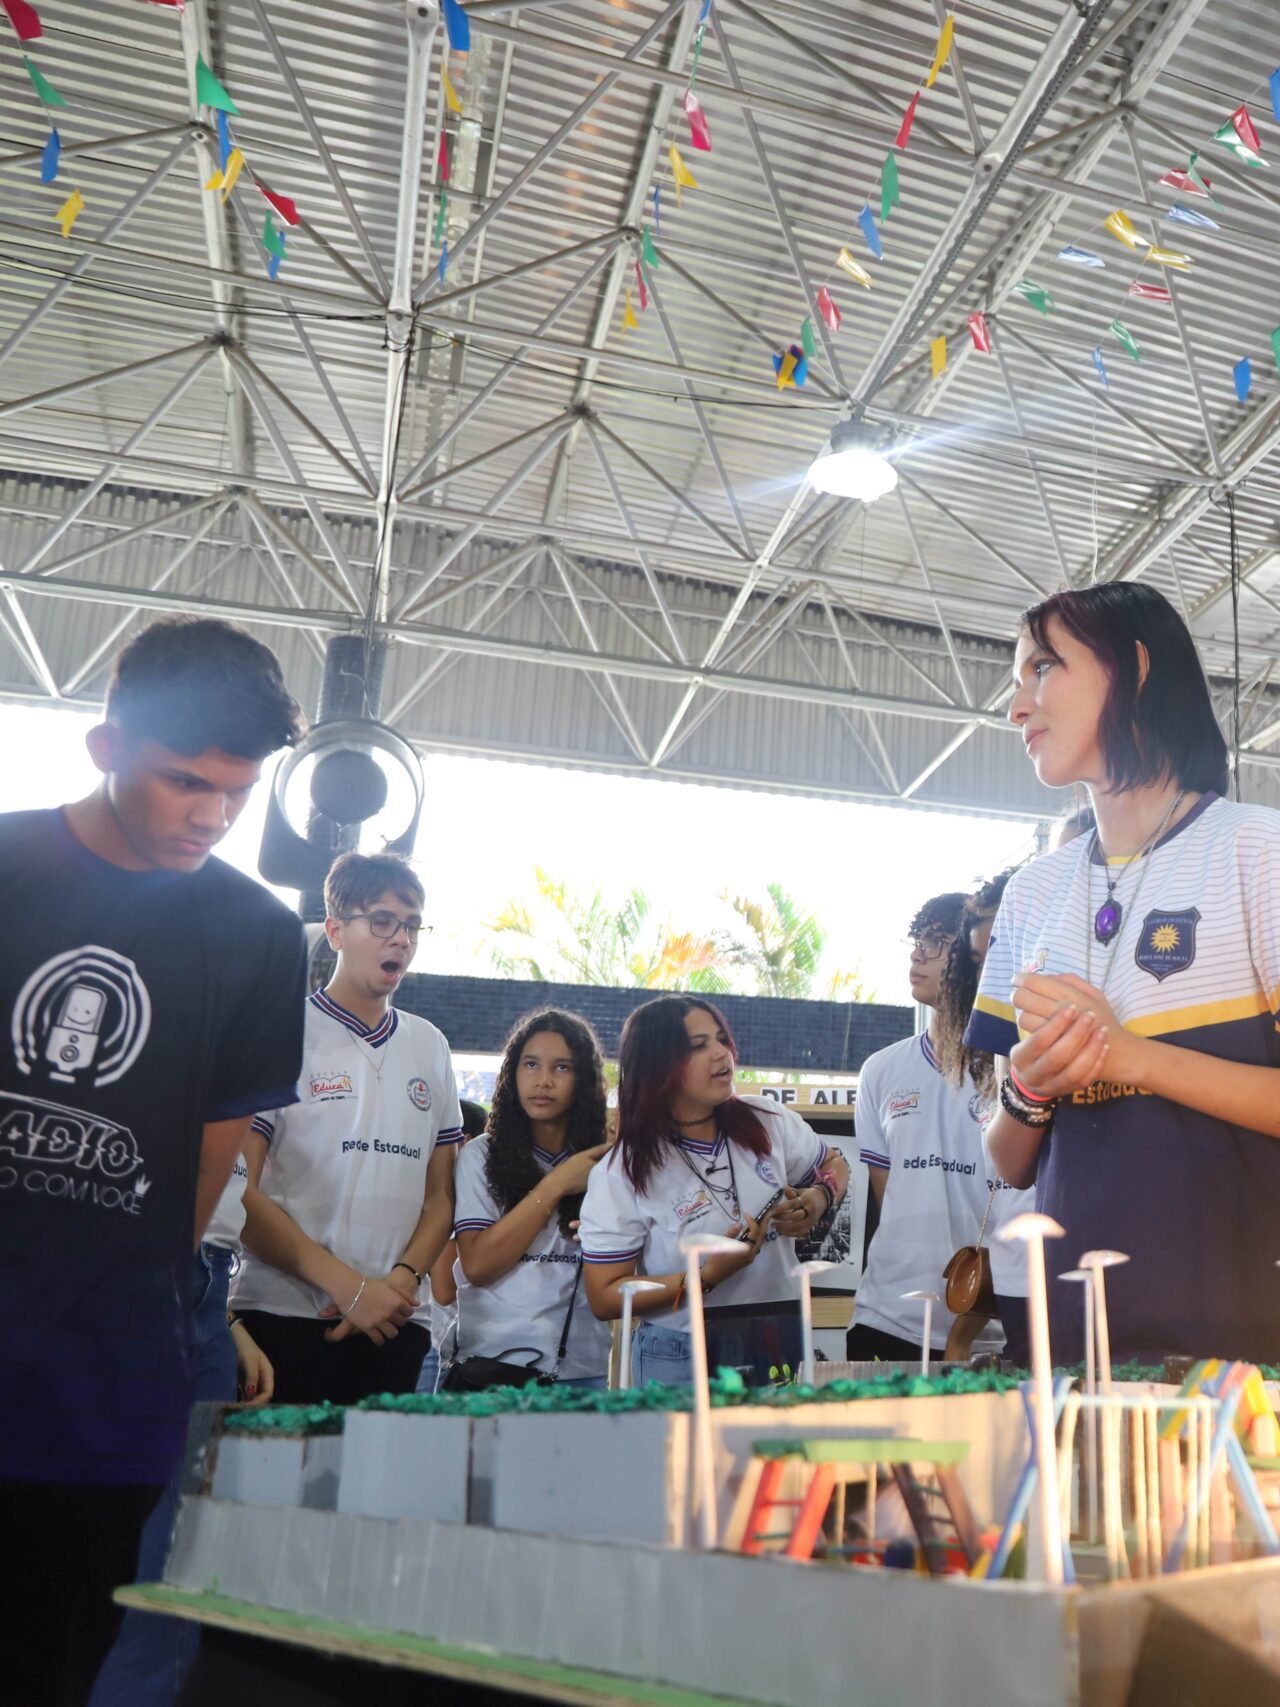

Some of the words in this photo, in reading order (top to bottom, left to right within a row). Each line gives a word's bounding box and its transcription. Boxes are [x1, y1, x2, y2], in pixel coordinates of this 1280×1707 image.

[313, 1082, 345, 1093] Educa
[0, 1110, 144, 1178] ADIO
[342, 1138, 369, 1154] Rede
[374, 1138, 421, 1160] Estadual
[903, 1155, 927, 1169] ede
[24, 1169, 89, 1201] COM
